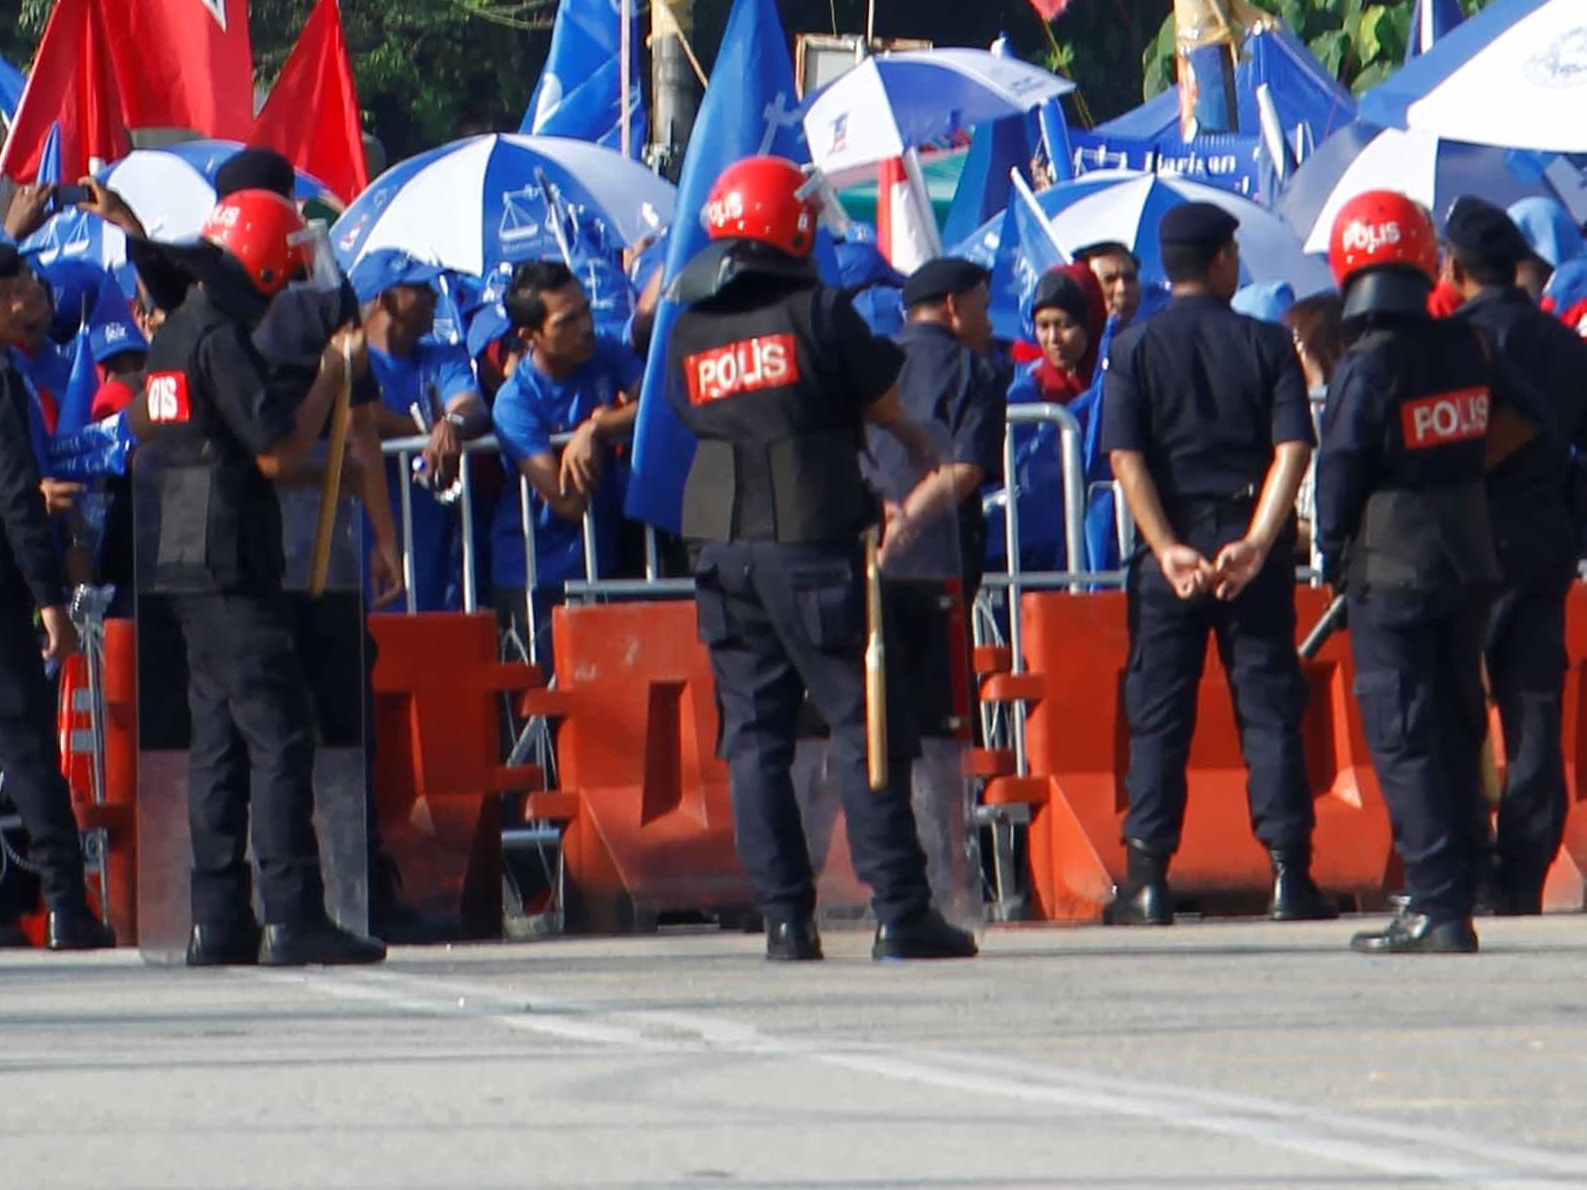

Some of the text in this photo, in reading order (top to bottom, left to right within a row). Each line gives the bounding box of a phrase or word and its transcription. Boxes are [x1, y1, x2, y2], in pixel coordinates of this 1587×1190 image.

[1342, 220, 1401, 252] POLIS
[698, 342, 788, 400] POLIS
[1413, 394, 1490, 442] POLIS
